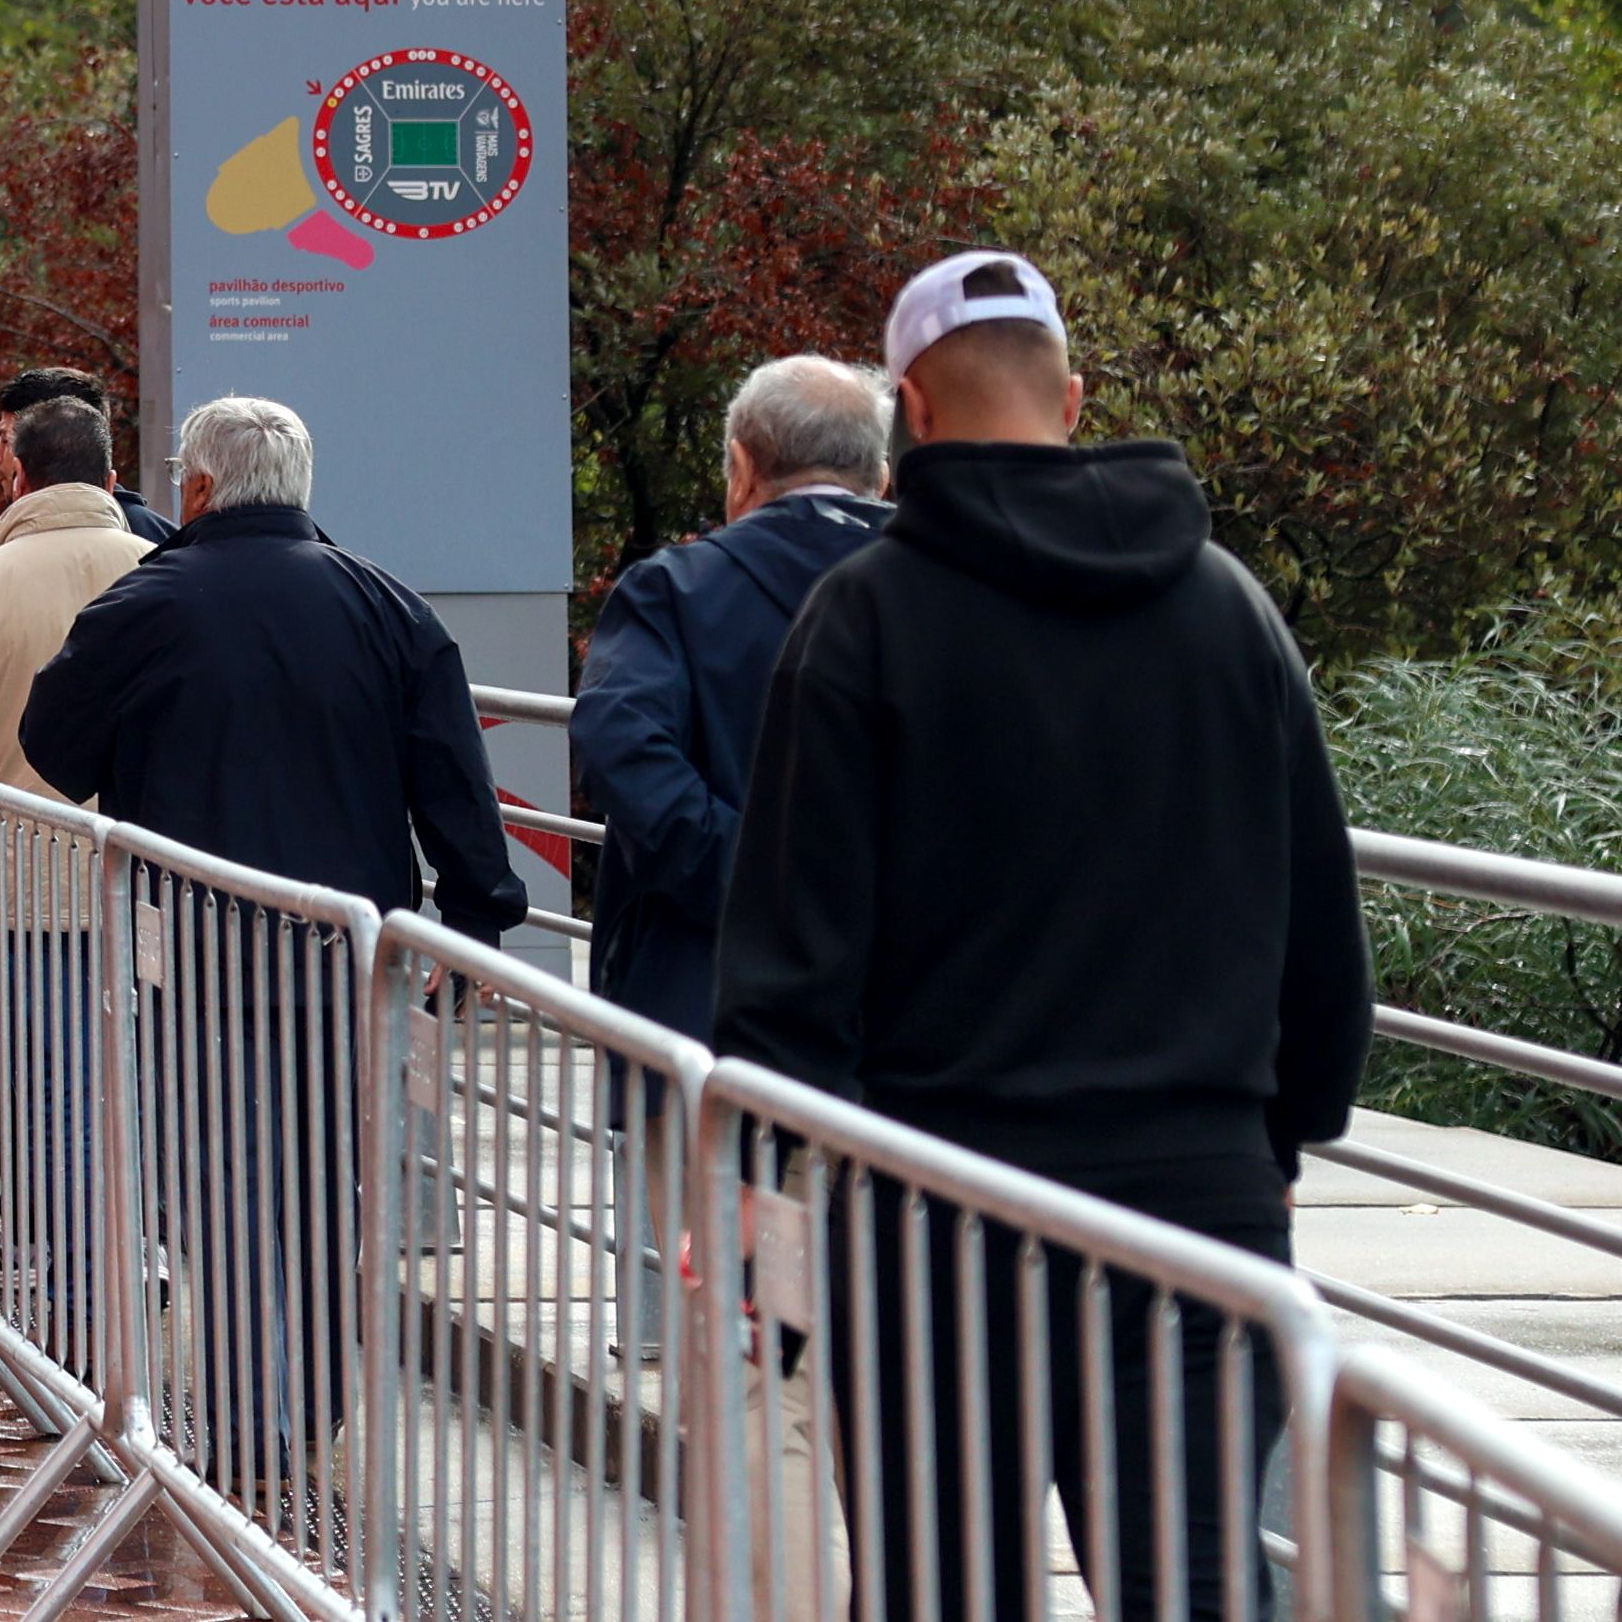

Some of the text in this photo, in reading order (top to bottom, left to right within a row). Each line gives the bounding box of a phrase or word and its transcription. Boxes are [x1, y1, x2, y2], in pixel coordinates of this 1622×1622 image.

[382, 80, 465, 100] Emirates
[354, 105, 373, 163] SAGRES
[209, 279, 345, 294] pavilhão desportivo
[209, 296, 281, 307] sports pavilion
[209, 314, 309, 328] área comercial
[209, 331, 289, 341] commercial area
